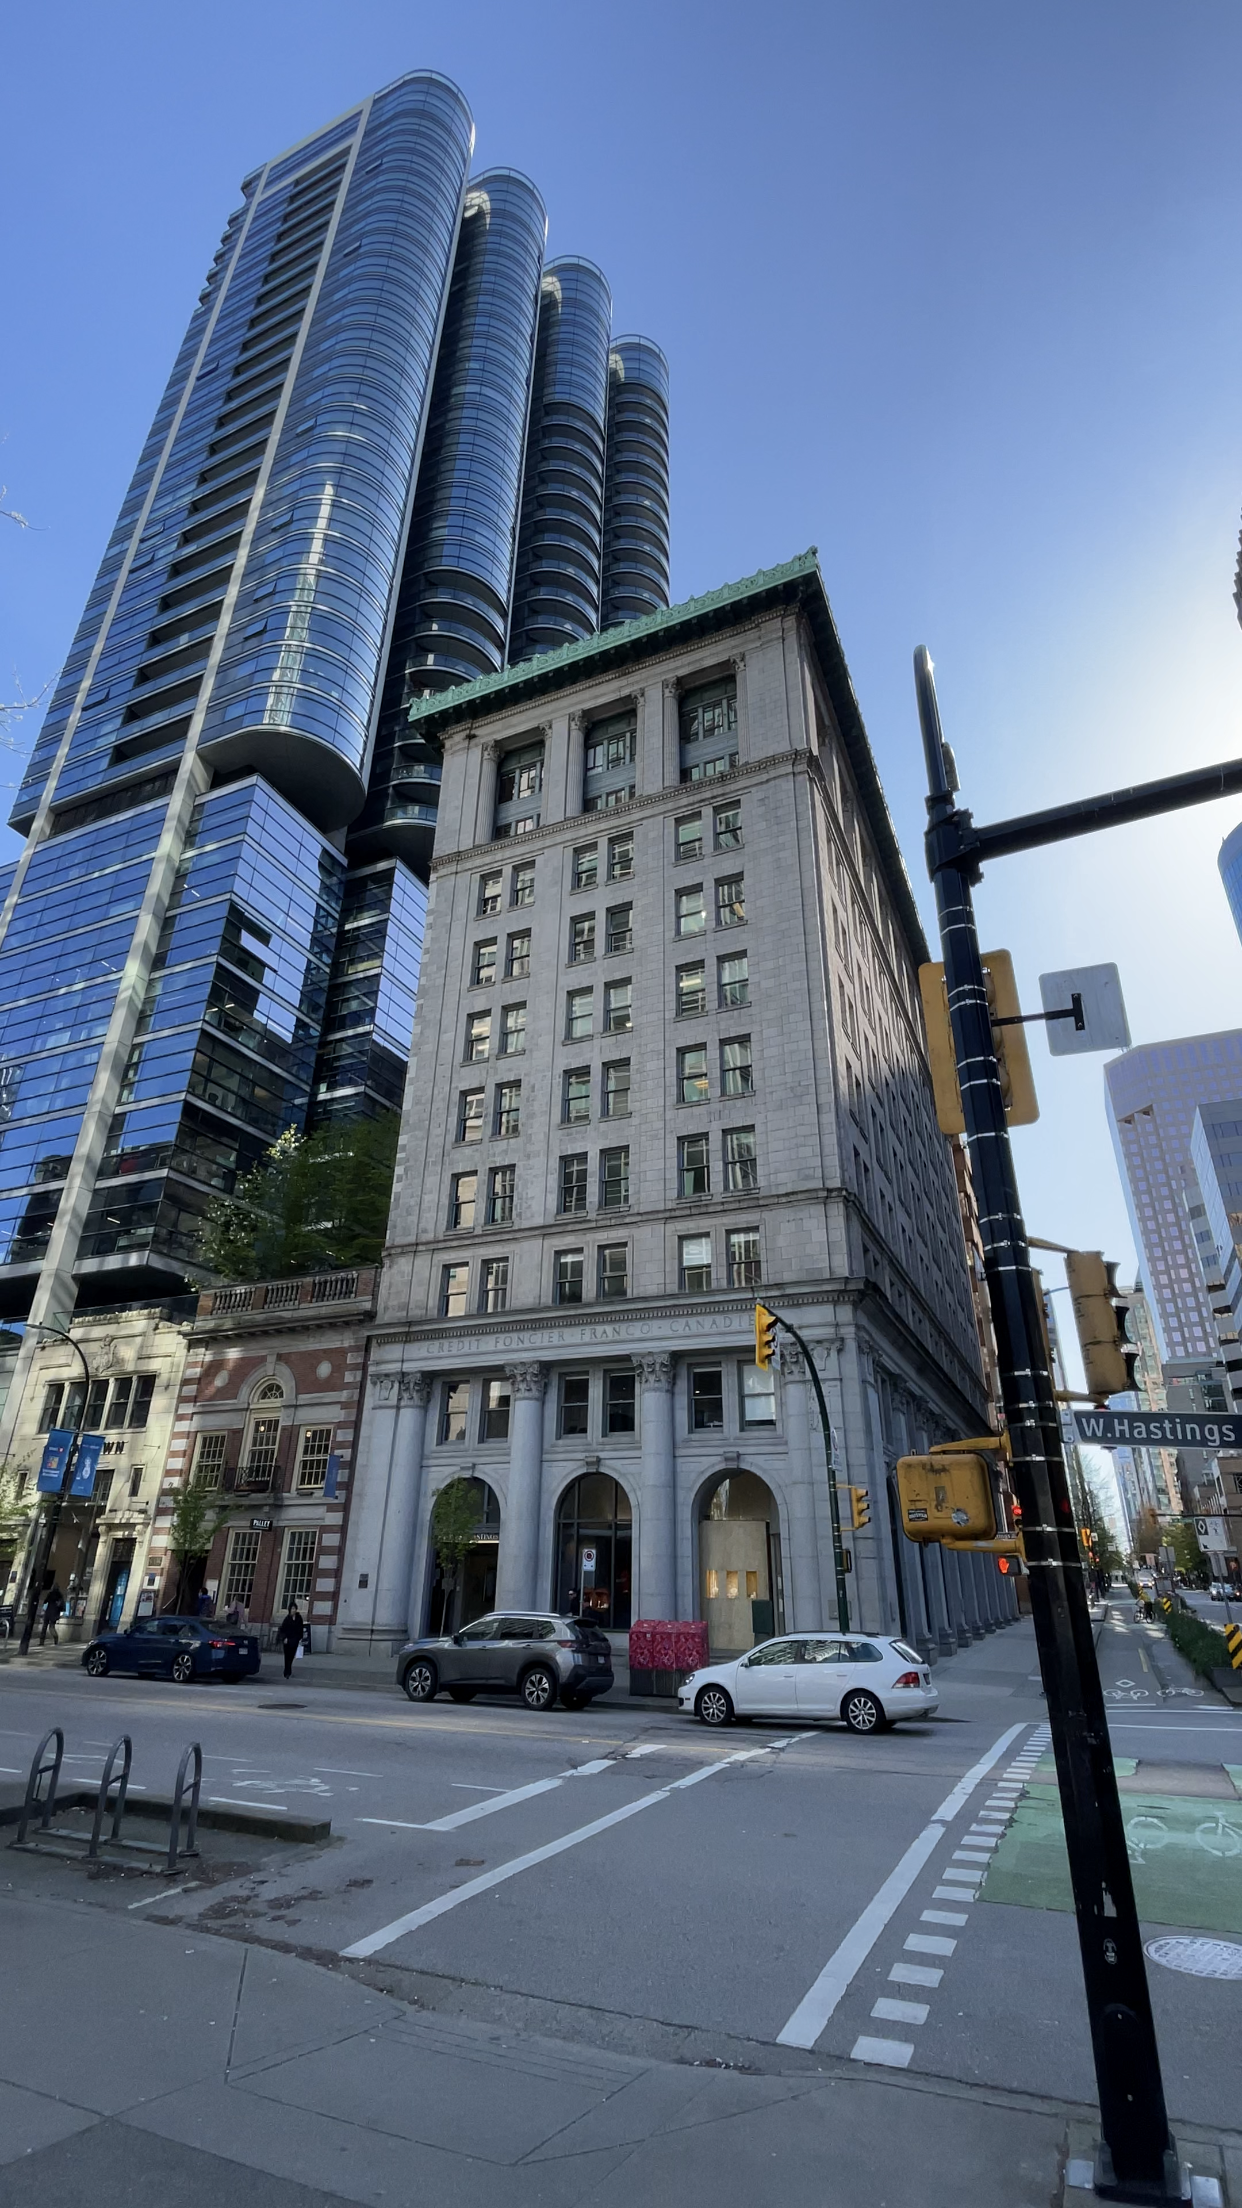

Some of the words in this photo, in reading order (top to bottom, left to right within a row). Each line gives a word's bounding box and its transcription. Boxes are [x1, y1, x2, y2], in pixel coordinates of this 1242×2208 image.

[426, 1338, 481, 1354] CREDIT
[494, 1331, 566, 1348] FONCIER
[580, 1323, 650, 1341] FRANCO
[669, 1314, 756, 1332] CANADIE
